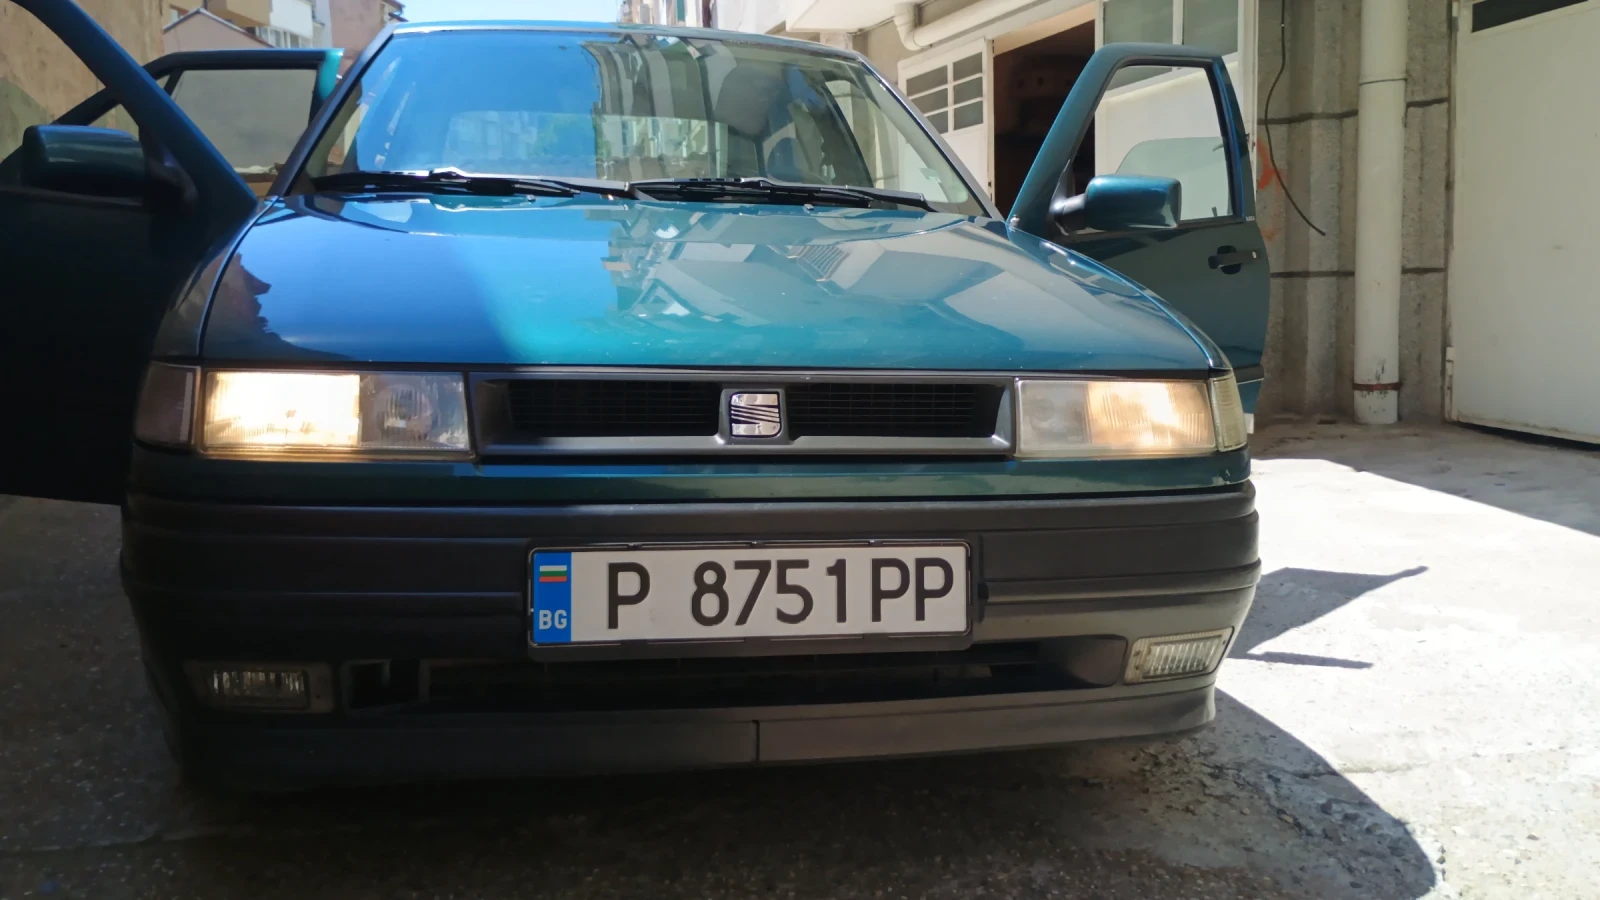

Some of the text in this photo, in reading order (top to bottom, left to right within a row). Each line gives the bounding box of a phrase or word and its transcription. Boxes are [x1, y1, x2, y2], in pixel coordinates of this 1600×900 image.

[608, 557, 954, 630] P 8751 PP
[539, 609, 568, 630] BG
